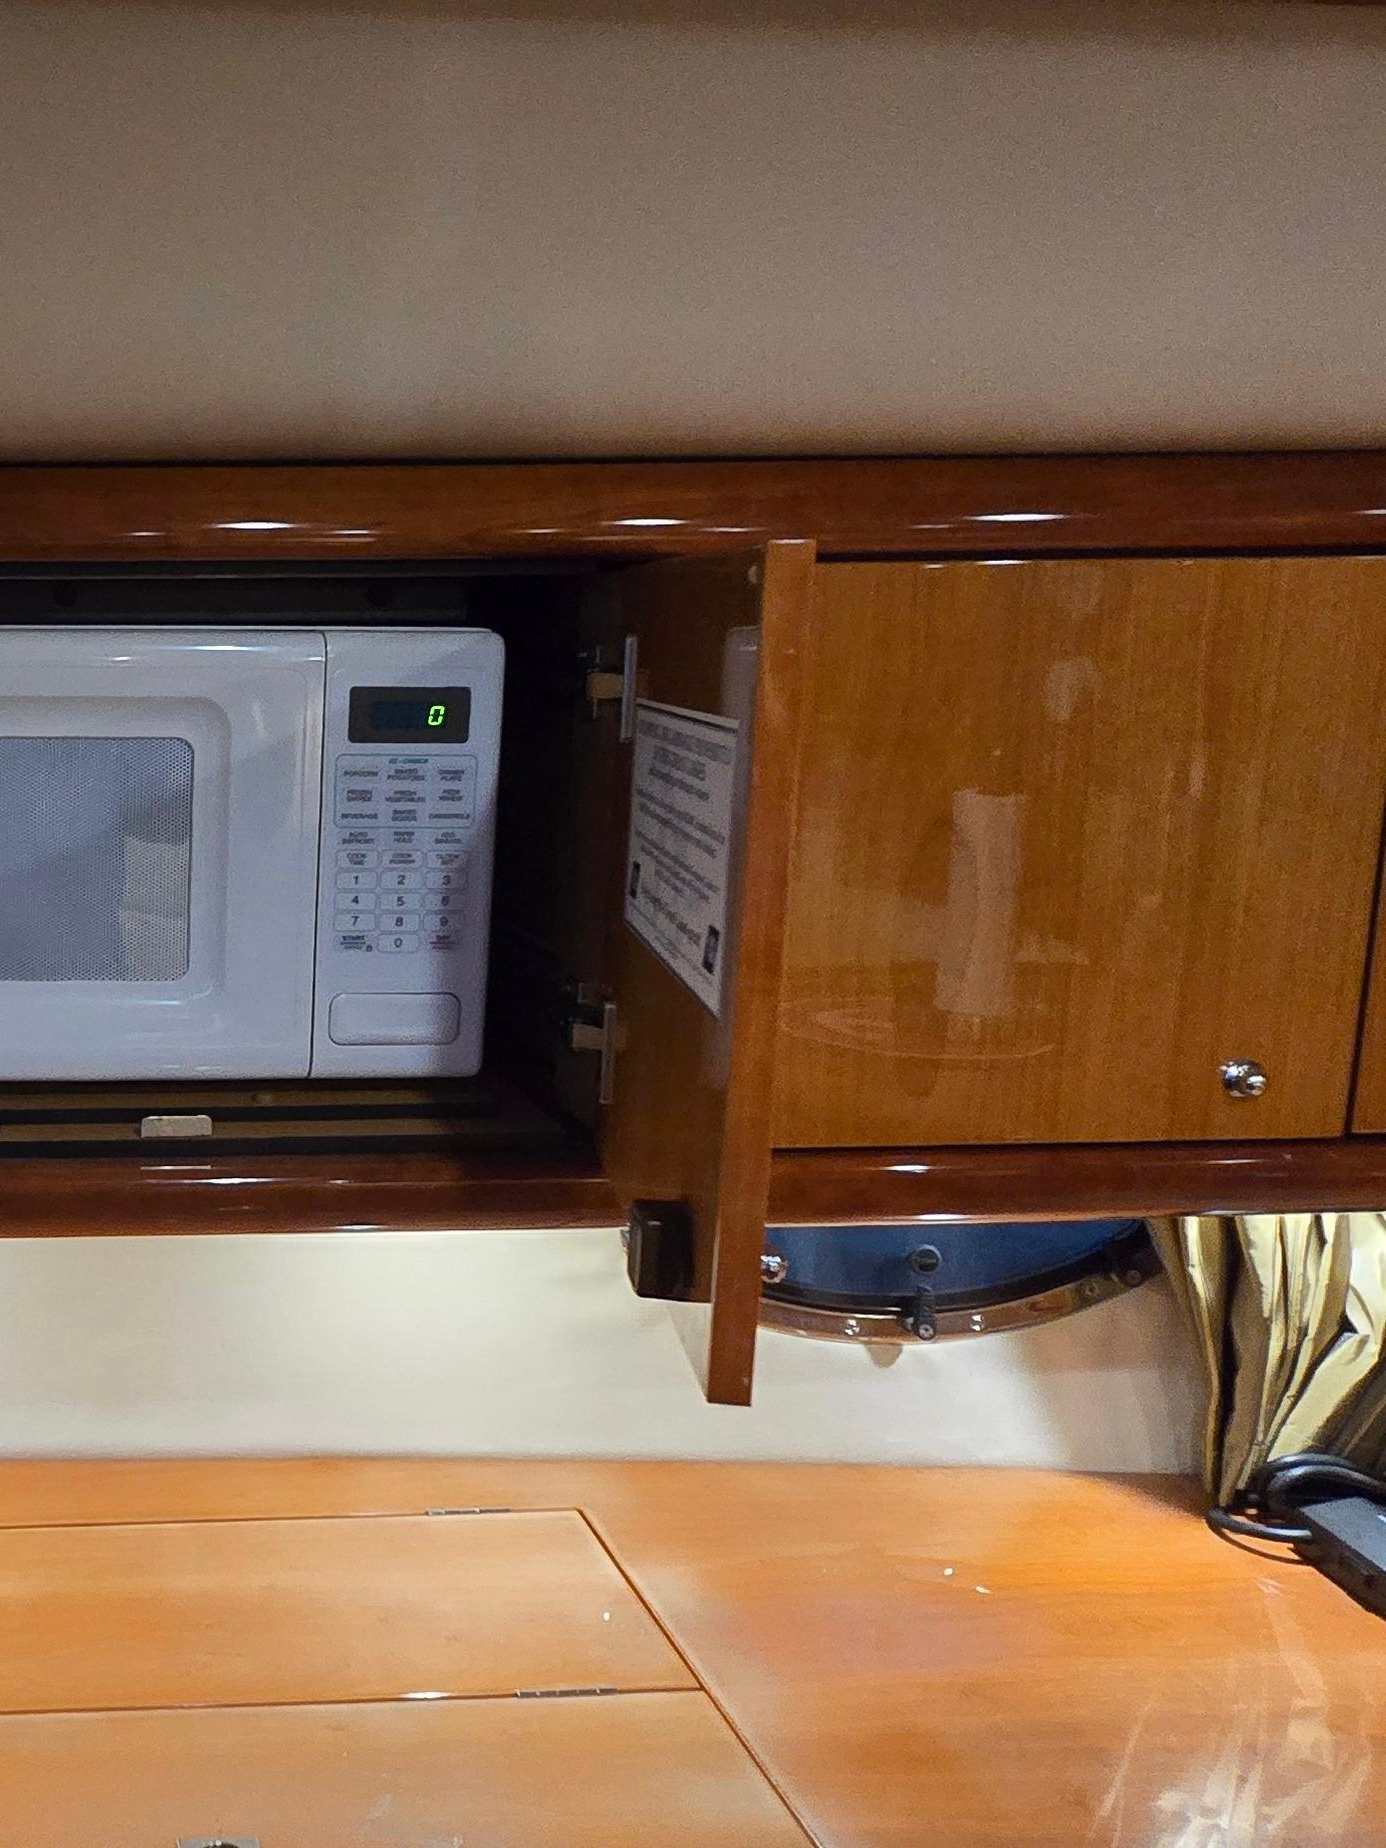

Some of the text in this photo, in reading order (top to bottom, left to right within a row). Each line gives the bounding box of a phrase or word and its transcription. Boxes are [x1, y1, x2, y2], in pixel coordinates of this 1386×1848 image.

[427, 705, 446, 726] 0
[353, 875, 359, 884] 1
[397, 875, 406, 884] 2
[443, 876, 451, 885] 3
[351, 896, 359, 904] 4
[397, 897, 405, 906] 5
[441, 896, 450, 906] 6
[351, 916, 360, 925] 7
[395, 917, 403, 926] 8
[440, 917, 448, 926] 9
[394, 938, 403, 947] 0
